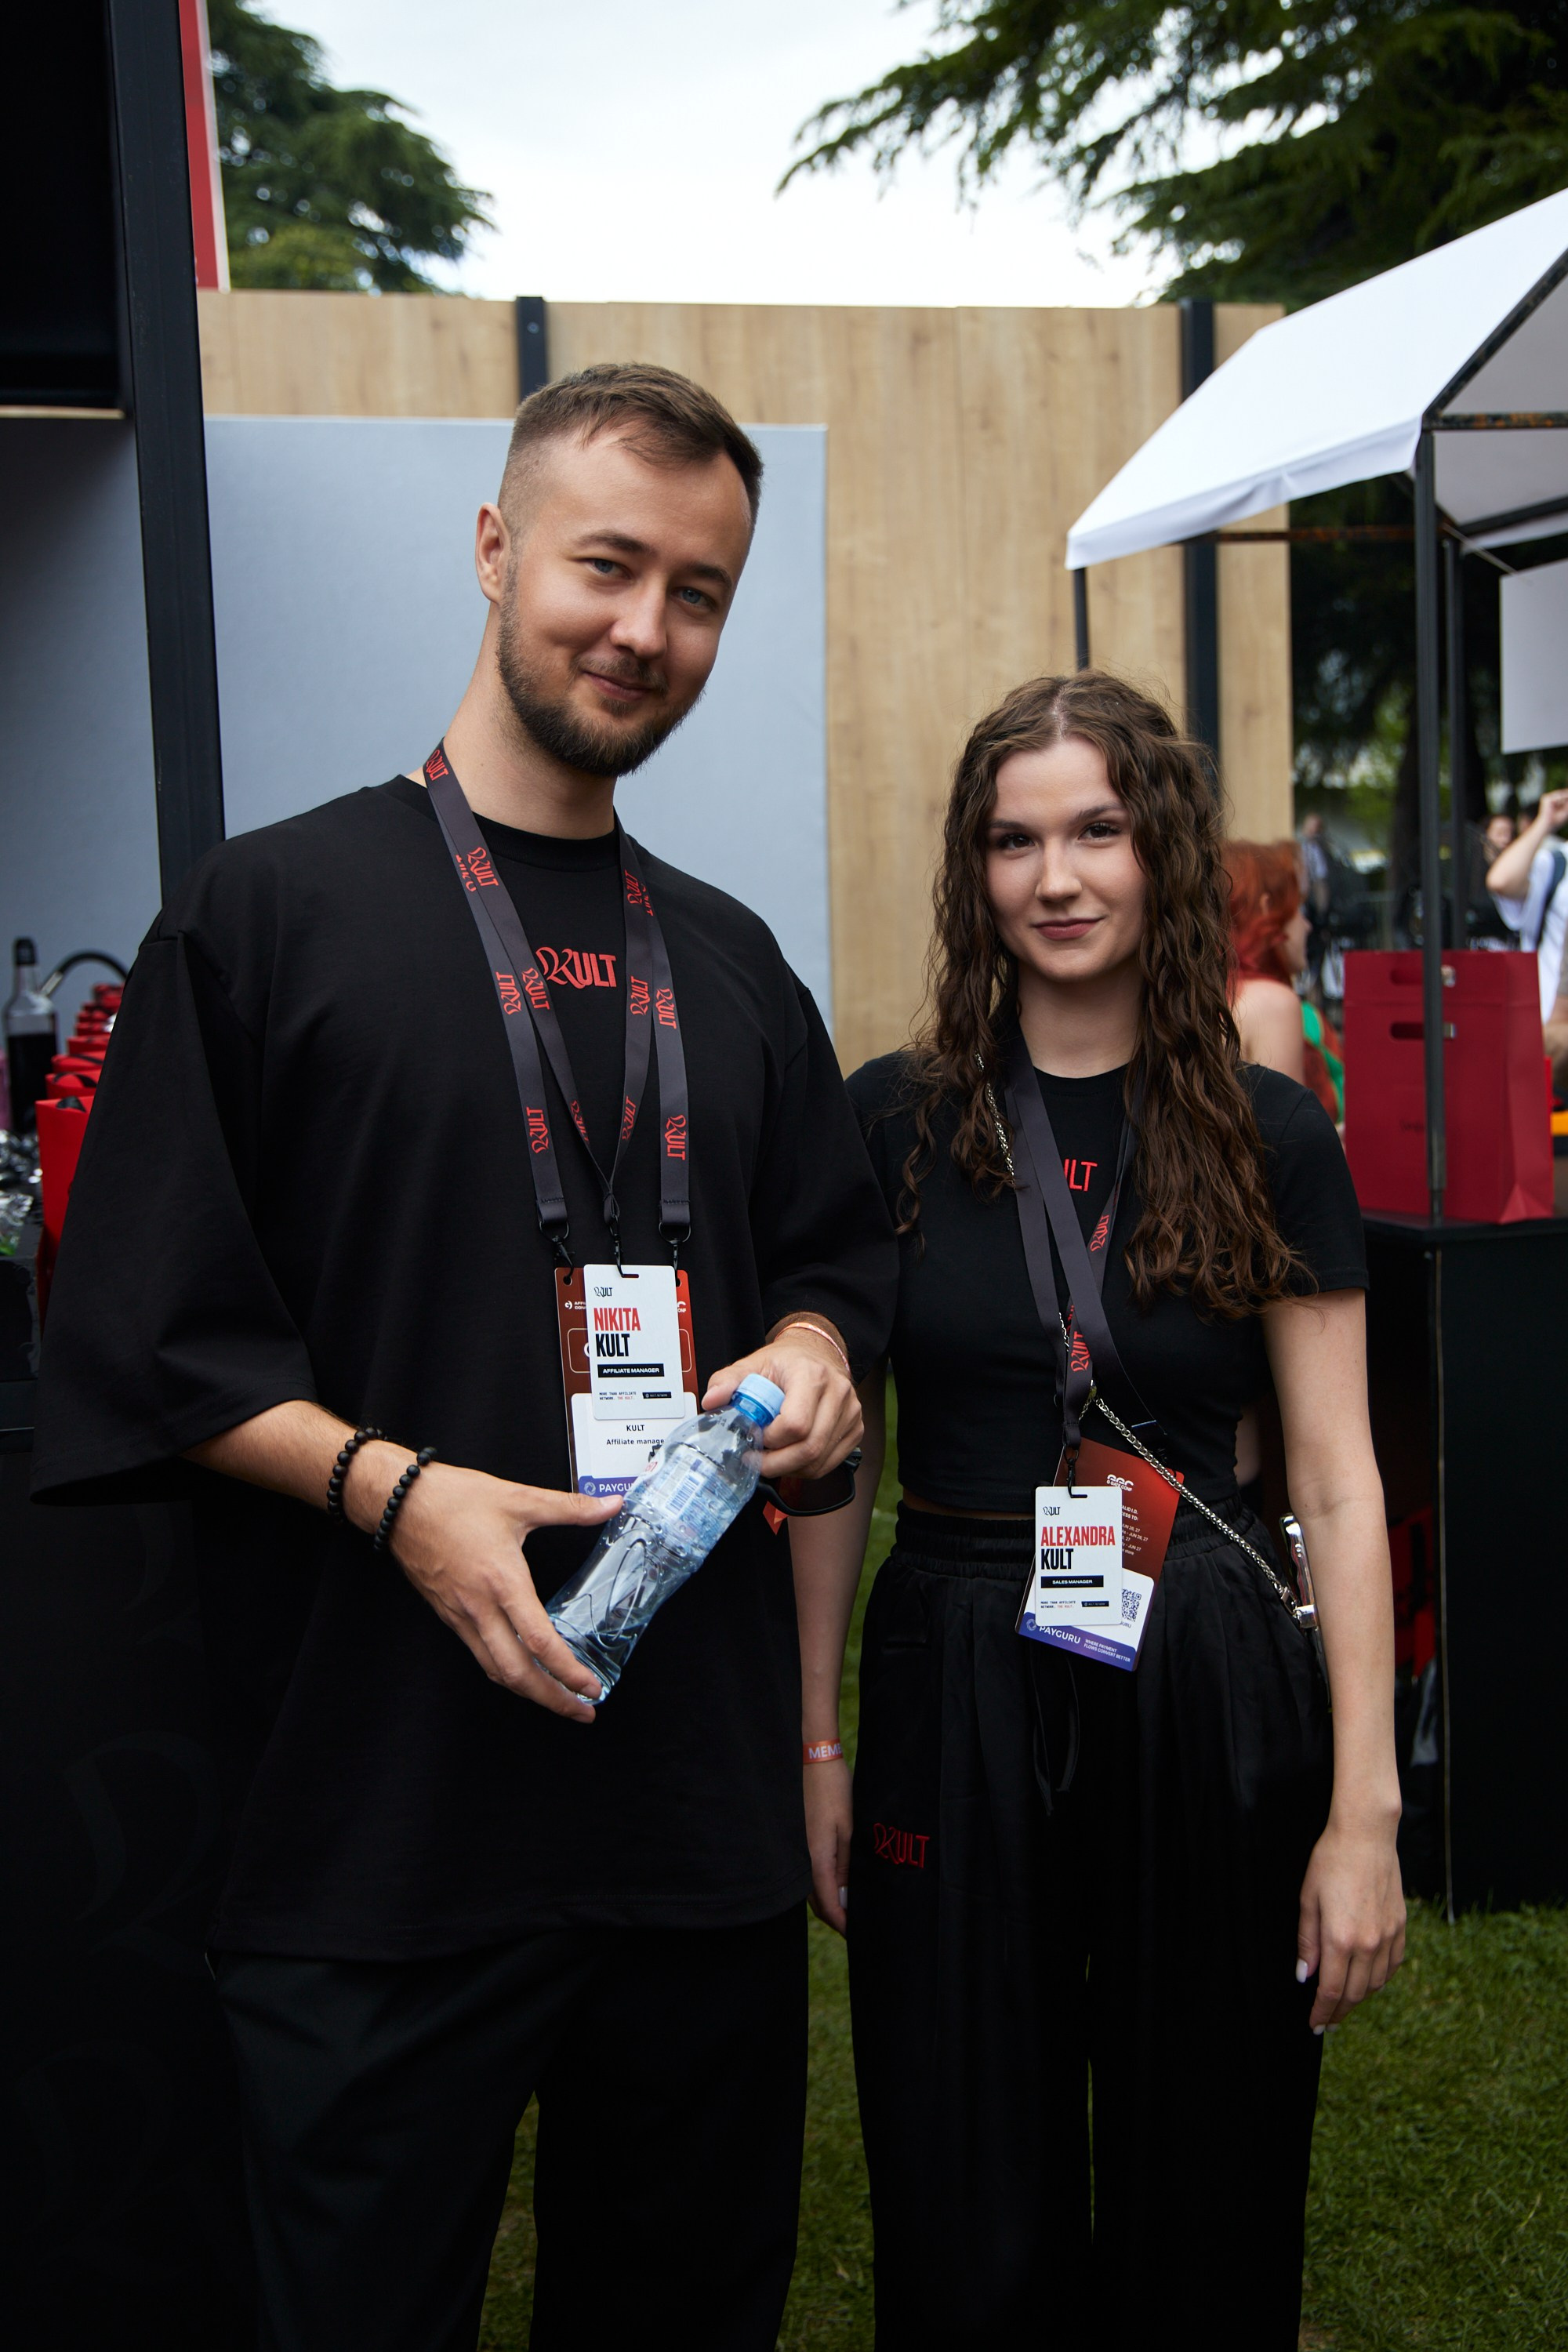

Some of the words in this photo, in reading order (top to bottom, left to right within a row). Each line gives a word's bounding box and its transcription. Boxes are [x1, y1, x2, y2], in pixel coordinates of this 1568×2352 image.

[535, 946, 617, 989] KULT
[593, 1308, 641, 1331] NIKITA
[595, 1334, 630, 1357] KULT
[1041, 1526, 1116, 1547] ALEXANDRA
[1041, 1548, 1074, 1570] KULT
[1039, 1625, 1081, 1644] PAYGURU
[1085, 1639, 1098, 1647] WHERE
[1098, 1643, 1117, 1653] PAYMENT
[1098, 1647, 1116, 1657] CONVERT
